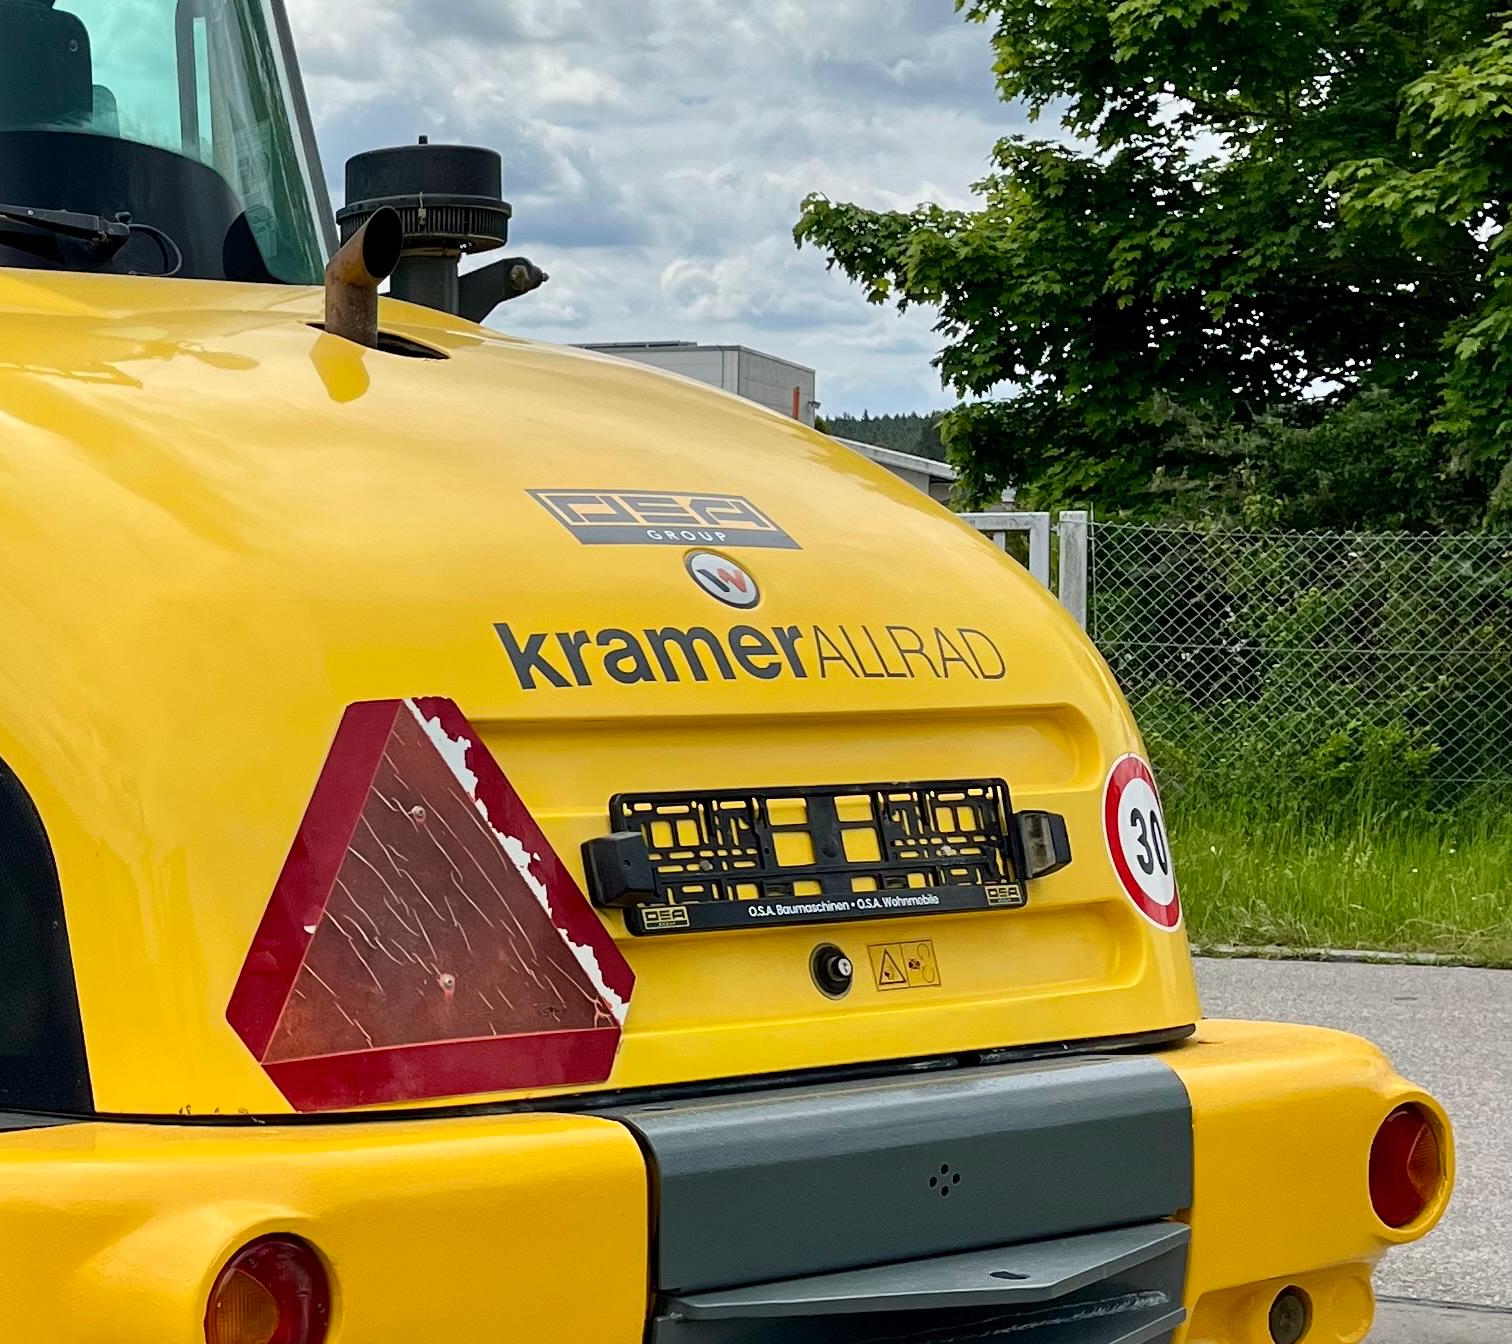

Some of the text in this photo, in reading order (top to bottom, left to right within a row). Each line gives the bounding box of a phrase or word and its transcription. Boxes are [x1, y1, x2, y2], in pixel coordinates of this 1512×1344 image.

[646, 528, 727, 543] GROUP
[1130, 807, 1168, 876] 30
[776, 899, 851, 916] Baumaschinen
[882, 892, 940, 910] Wohnmobile
